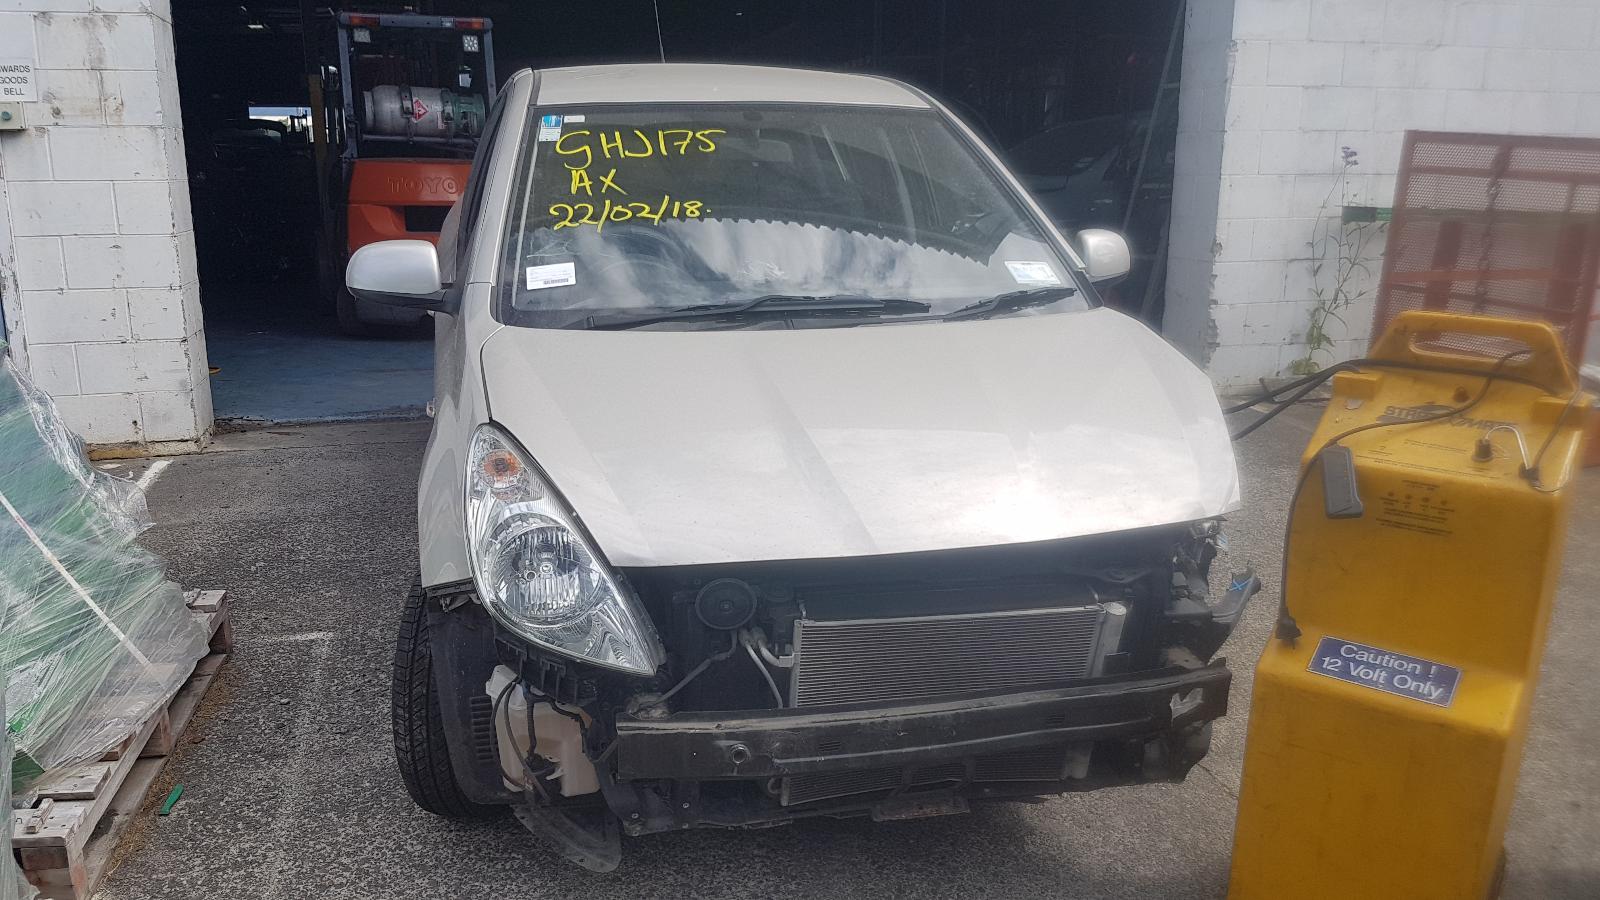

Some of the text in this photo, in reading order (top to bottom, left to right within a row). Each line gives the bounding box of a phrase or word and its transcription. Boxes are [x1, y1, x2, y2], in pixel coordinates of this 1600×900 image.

[0, 76, 28, 84] GOODS
[1340, 644, 1421, 675] Caution
[1321, 656, 1444, 699] 12 Volt Only
